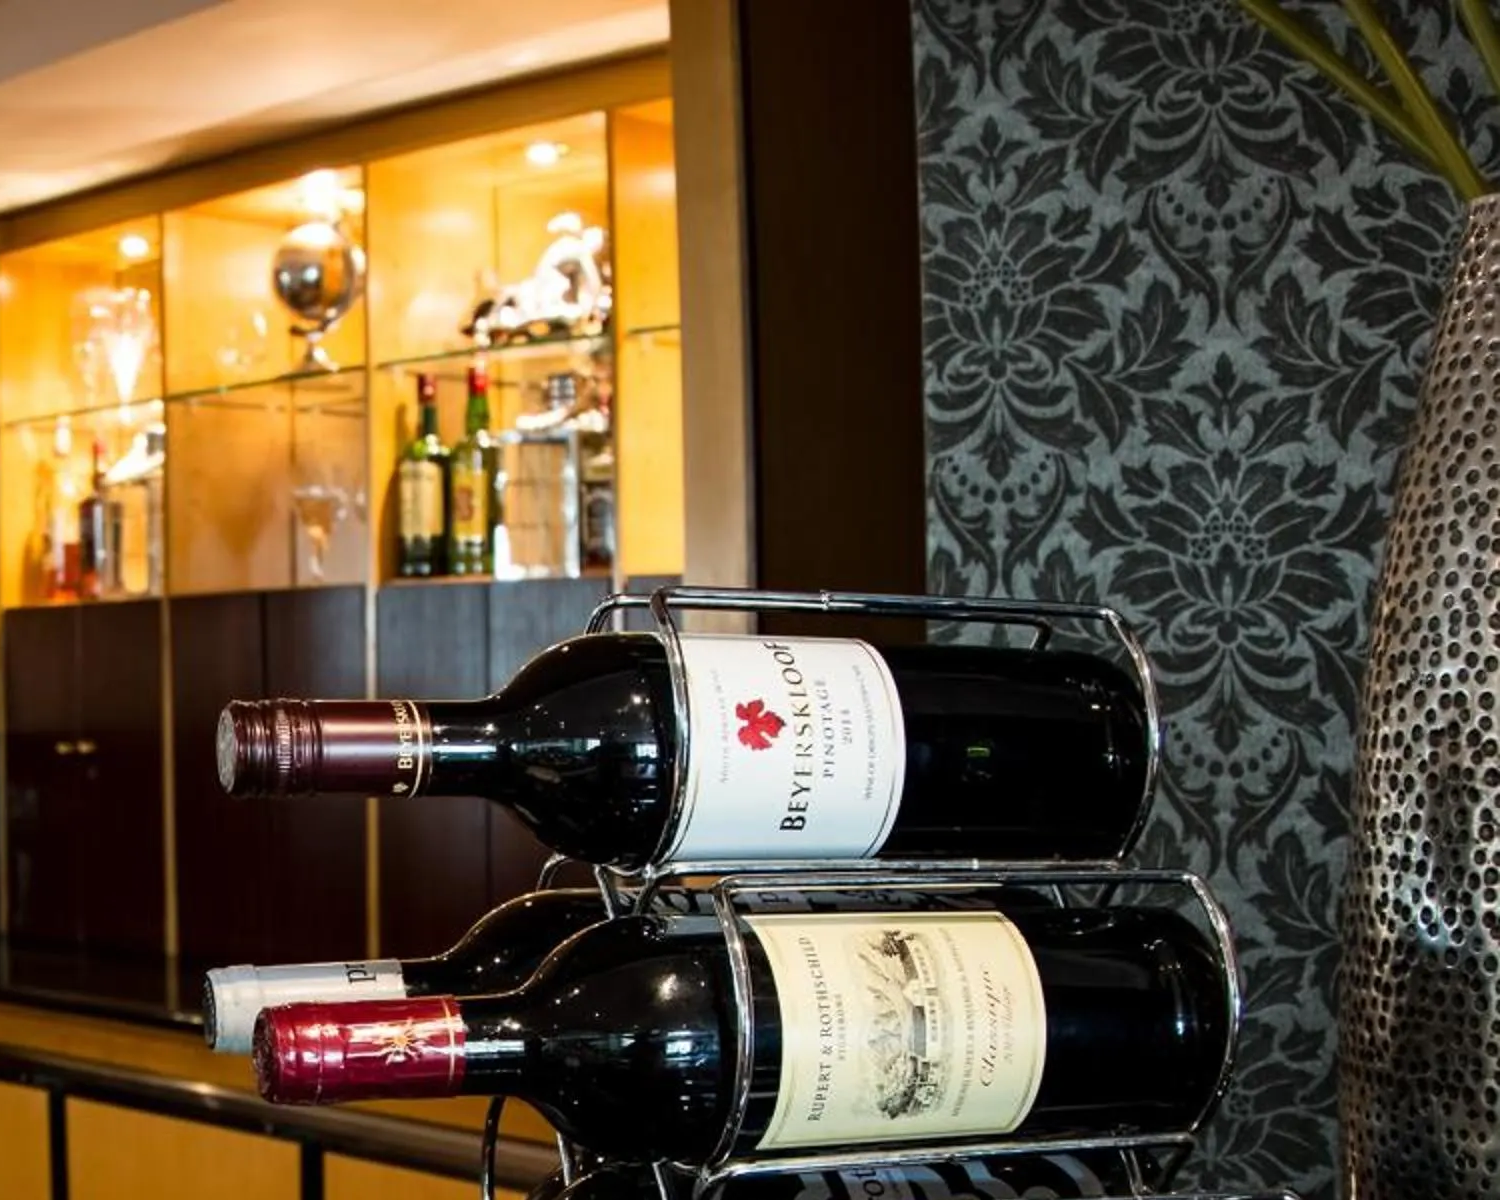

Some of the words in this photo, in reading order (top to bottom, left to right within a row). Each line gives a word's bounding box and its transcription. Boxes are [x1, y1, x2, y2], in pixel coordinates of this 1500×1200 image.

[814, 678, 836, 779] PINOTAGE
[798, 936, 832, 1039] ROTHSCHILD
[820, 1043, 833, 1057] &
[806, 1061, 832, 1122] RUPERT
